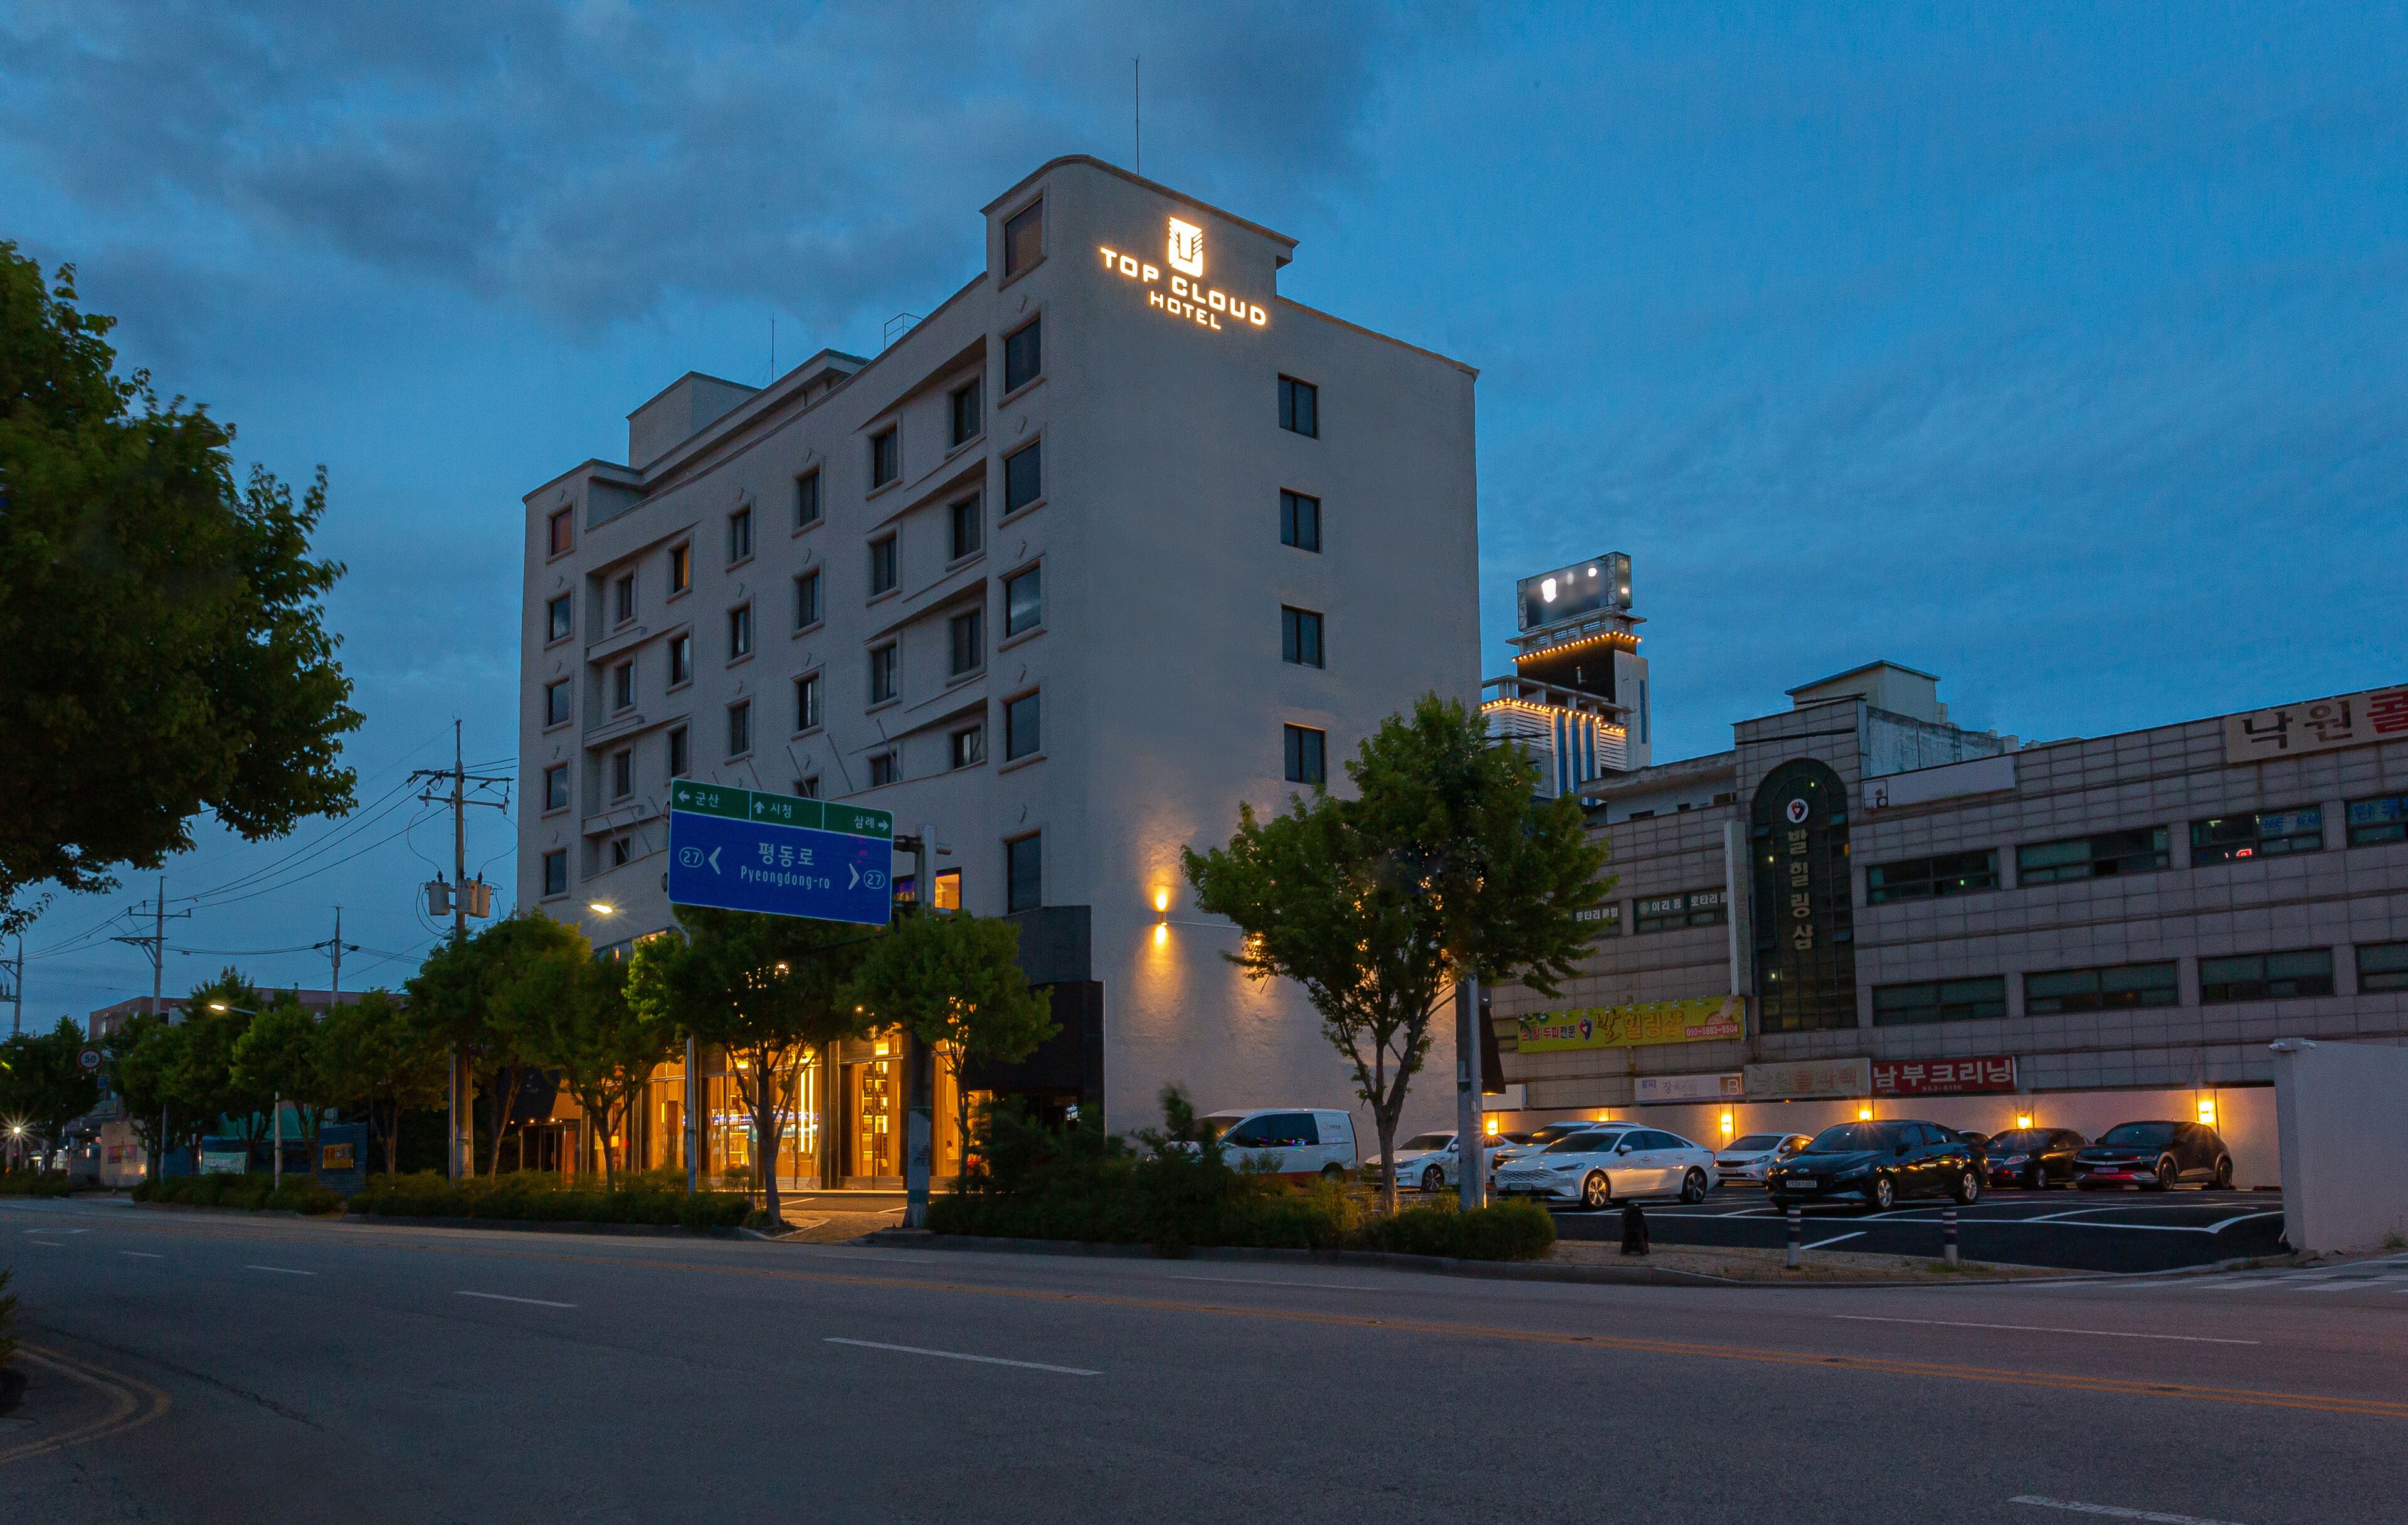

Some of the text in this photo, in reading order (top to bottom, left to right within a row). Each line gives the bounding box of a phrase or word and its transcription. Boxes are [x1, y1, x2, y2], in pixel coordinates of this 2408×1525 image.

[1101, 248, 1267, 326] TOP CLOUD
[1150, 290, 1221, 330] HOTEL
[695, 792, 719, 808] 군산
[770, 803, 792, 818] 시청
[854, 815, 875, 829] 삼례
[683, 852, 699, 864] 27
[759, 843, 814, 867] 평동로
[741, 865, 830, 890] Pyeongdong-ro
[867, 874, 882, 886] 27
[83, 1055, 97, 1063] 50
[1873, 1059, 2012, 1089] 남부크리닝
